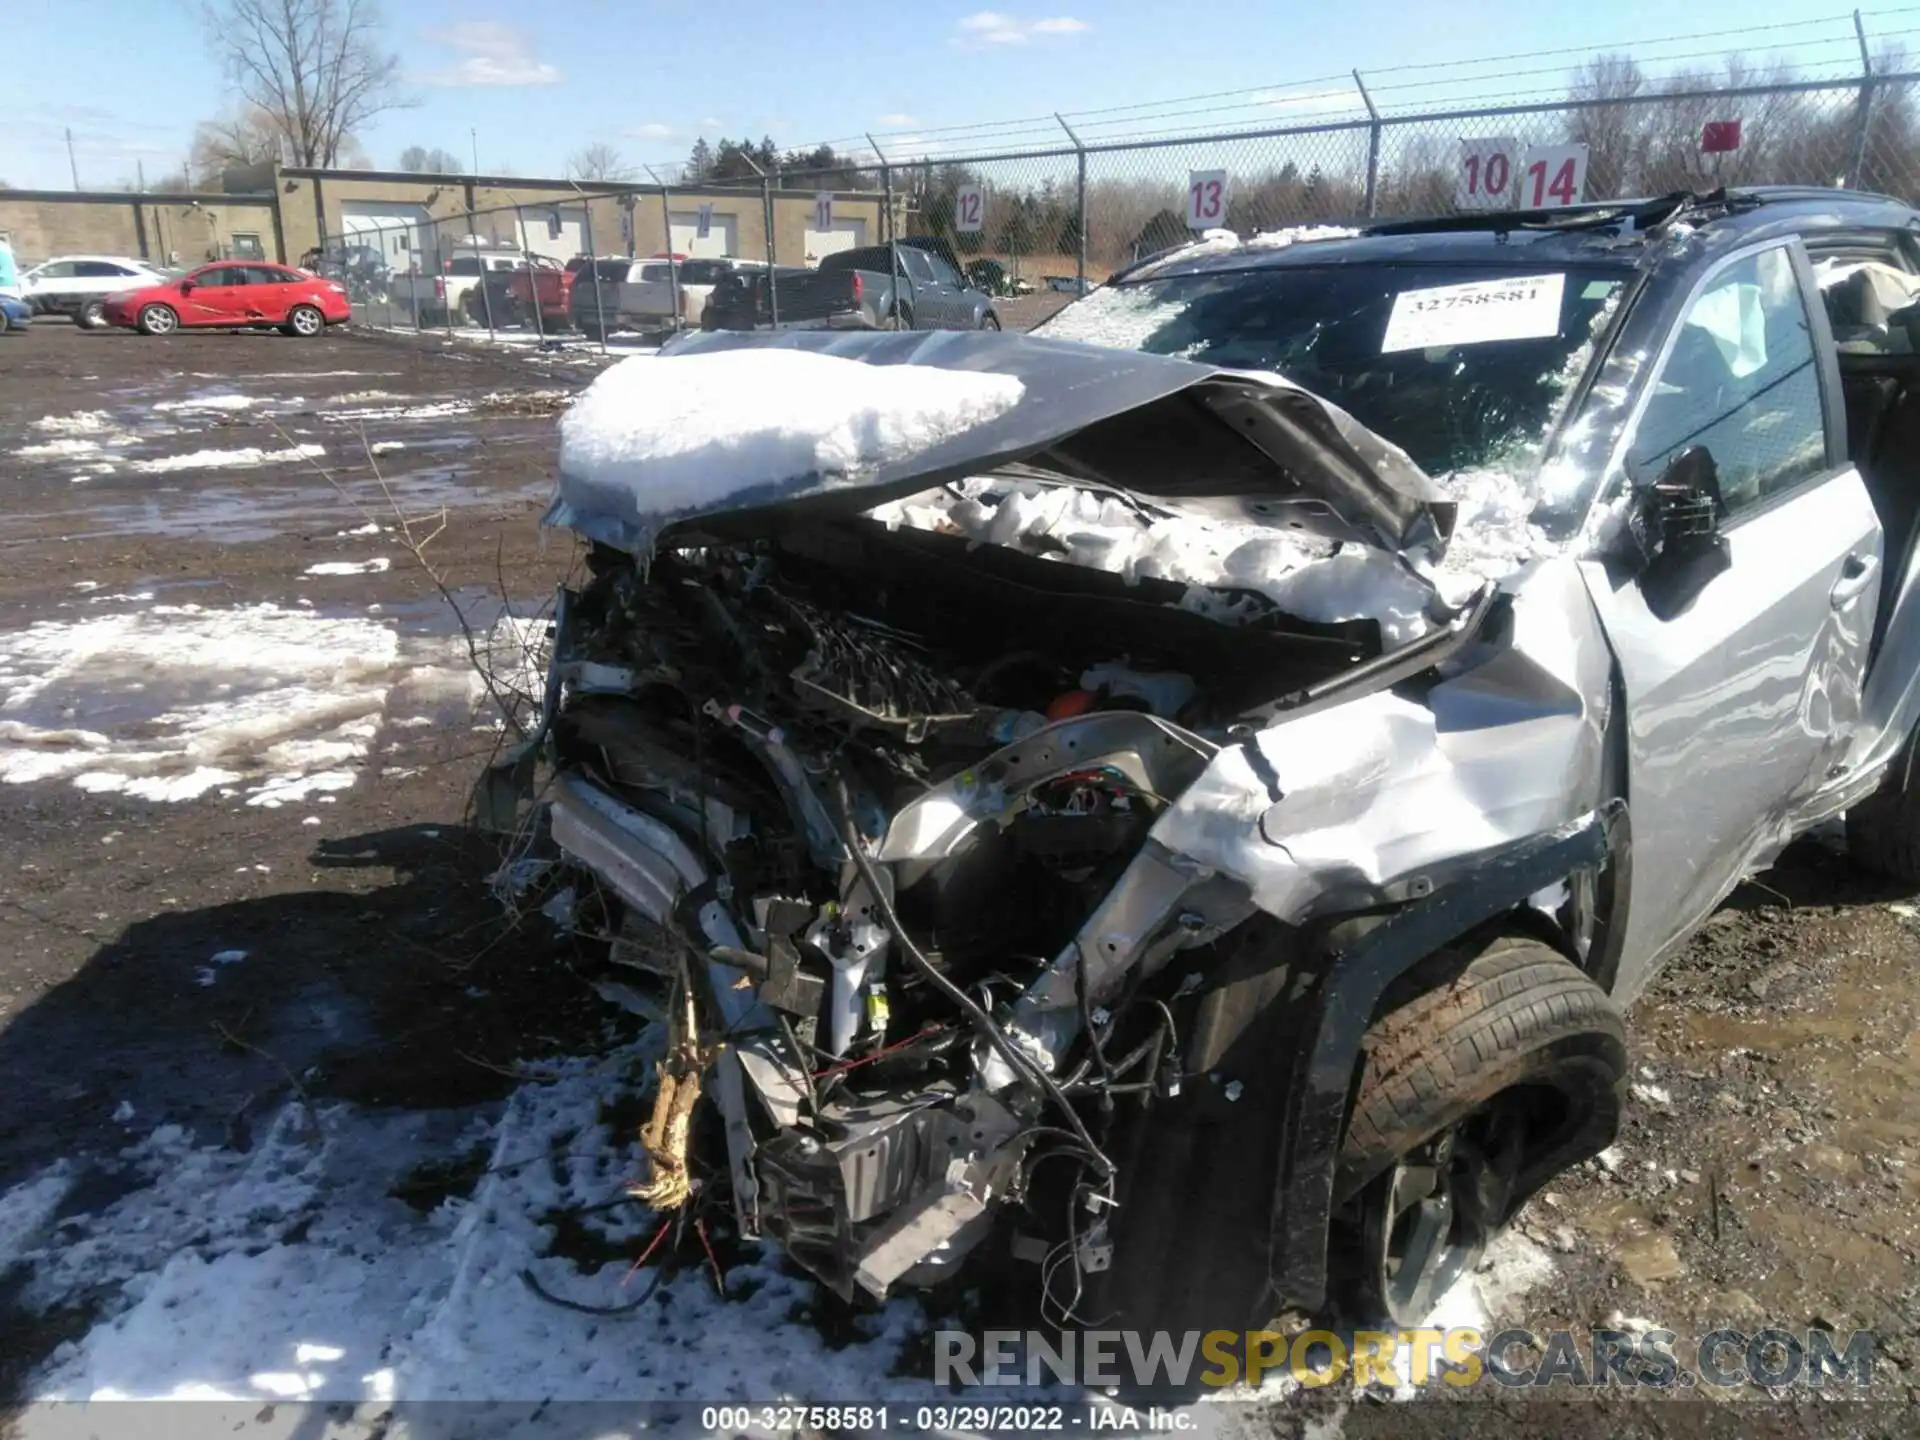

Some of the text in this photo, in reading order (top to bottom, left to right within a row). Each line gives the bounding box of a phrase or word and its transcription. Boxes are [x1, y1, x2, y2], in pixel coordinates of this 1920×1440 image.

[1464, 152, 1509, 195] 10
[1528, 157, 1578, 207] 14
[817, 200, 832, 227] 11
[959, 193, 981, 224] 12
[1192, 180, 1222, 218] 13
[1409, 287, 1539, 314] 32758581
